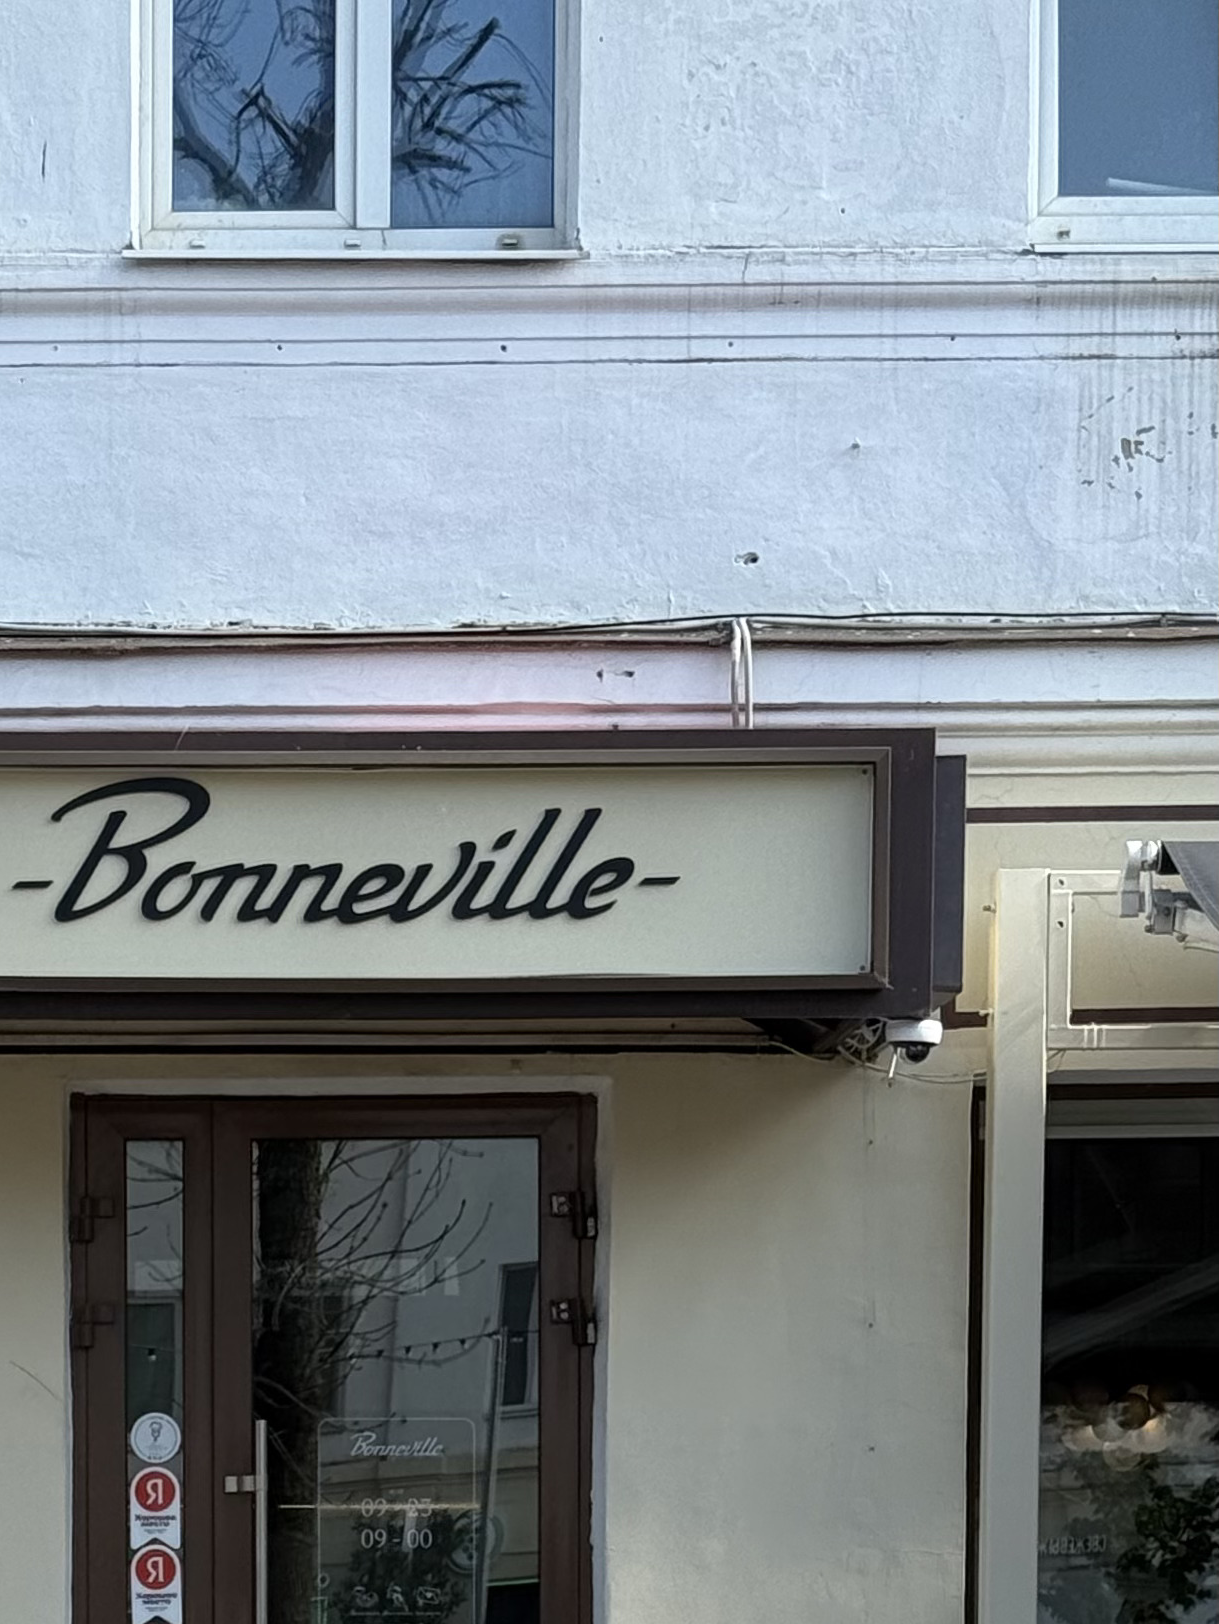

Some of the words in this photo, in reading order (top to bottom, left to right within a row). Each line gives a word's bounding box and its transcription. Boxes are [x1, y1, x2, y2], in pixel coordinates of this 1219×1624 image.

[349, 1431, 444, 1457] Bonneville
[146, 1478, 163, 1505] Я
[361, 1498, 387, 1517] 09
[361, 1528, 387, 1549] 09
[407, 1528, 433, 1549] 00
[146, 1556, 164, 1583] Я
